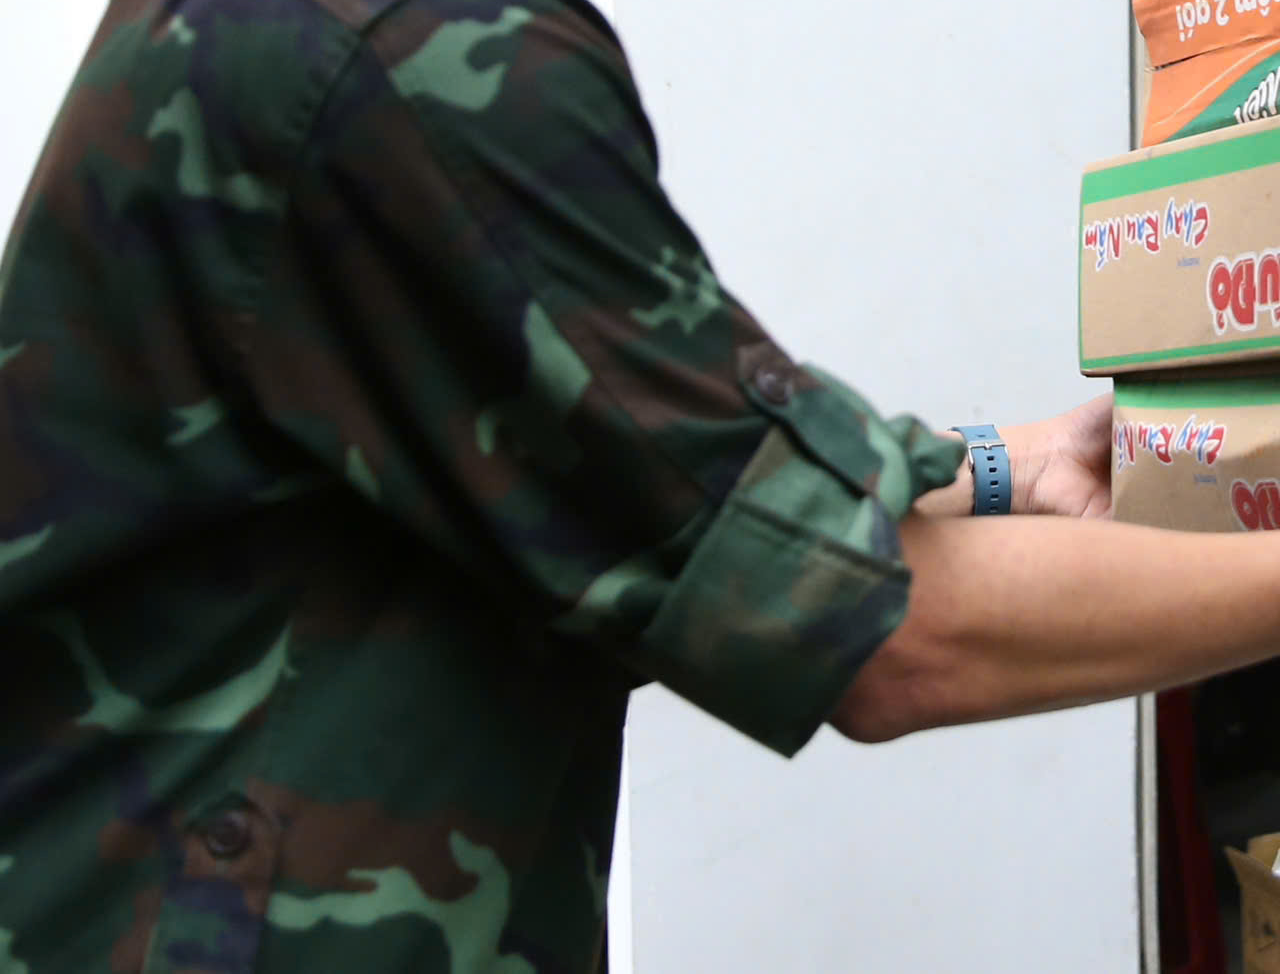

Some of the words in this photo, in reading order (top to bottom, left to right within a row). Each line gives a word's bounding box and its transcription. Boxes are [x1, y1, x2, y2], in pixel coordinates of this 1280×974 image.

[1214, 0, 1230, 27] 2
[1084, 218, 1120, 268] Nấm
[1127, 212, 1159, 251] Rau
[1166, 199, 1208, 246] Chay
[1138, 424, 1172, 464] Rau
[1177, 418, 1224, 464] Chay
